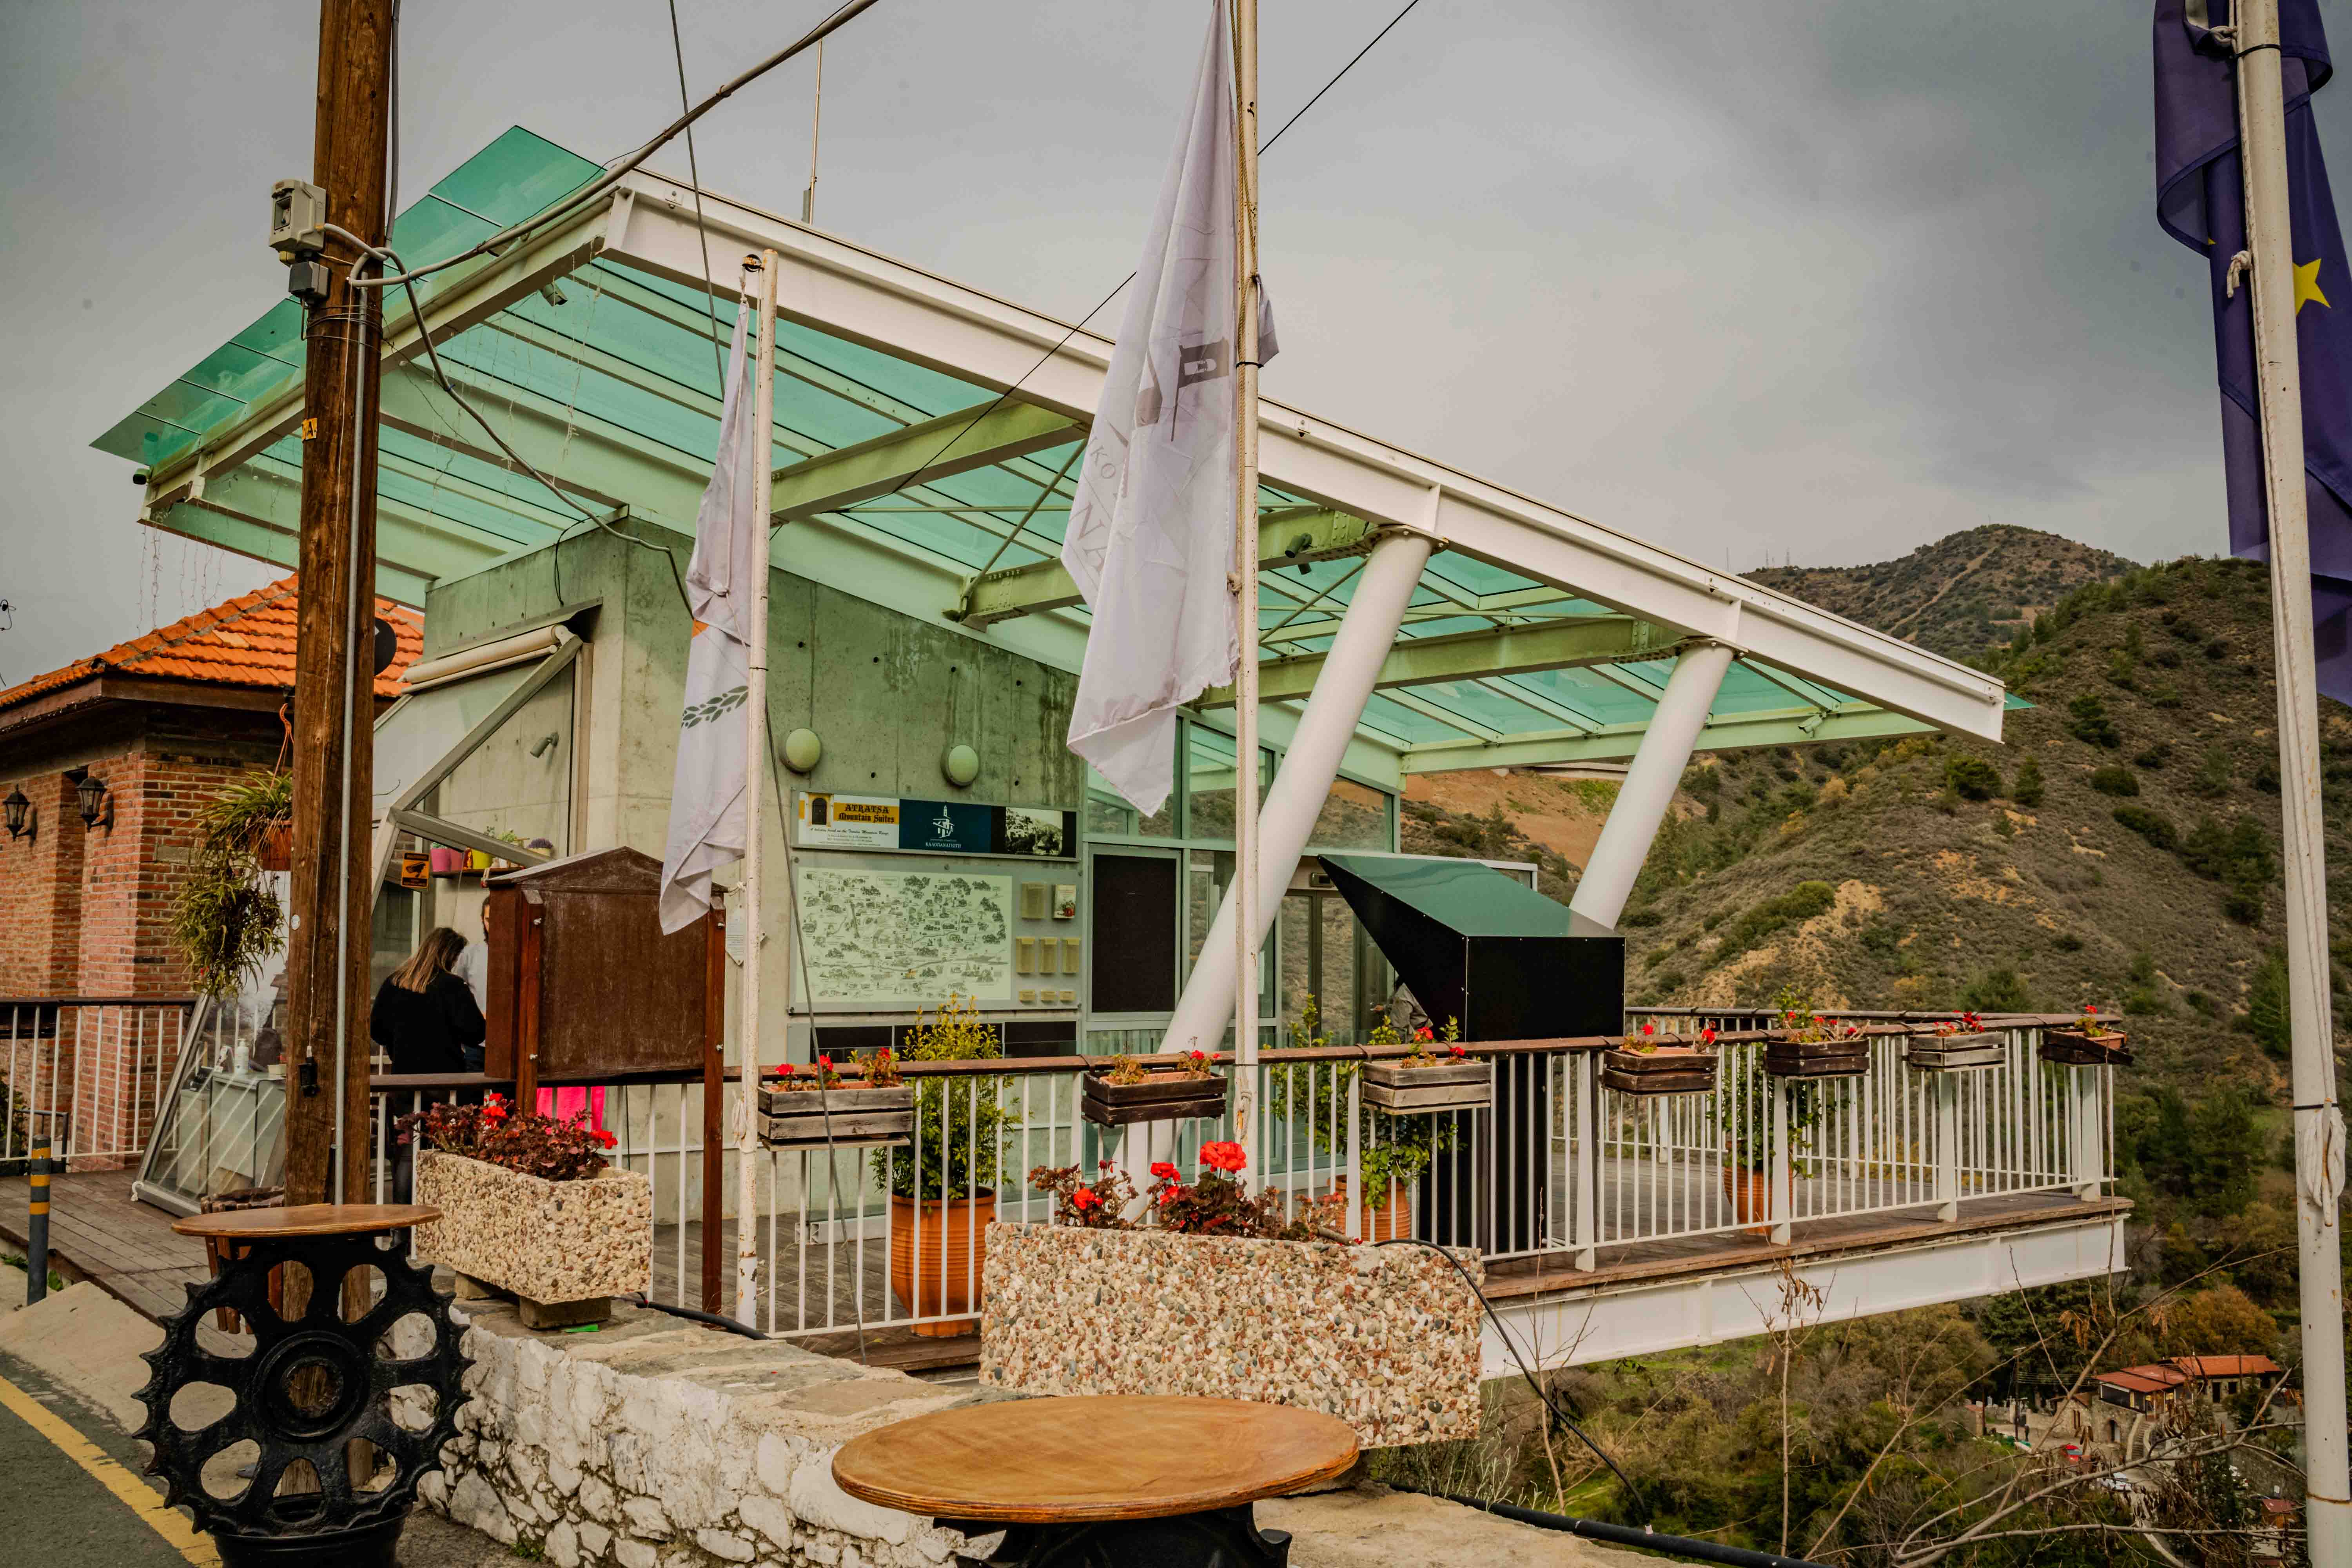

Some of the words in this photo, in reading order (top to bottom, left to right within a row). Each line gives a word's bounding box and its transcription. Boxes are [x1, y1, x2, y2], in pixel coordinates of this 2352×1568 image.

[844, 804, 889, 814] ATRATSA
[838, 812, 871, 822] Mountain
[873, 814, 895, 823] Suites
